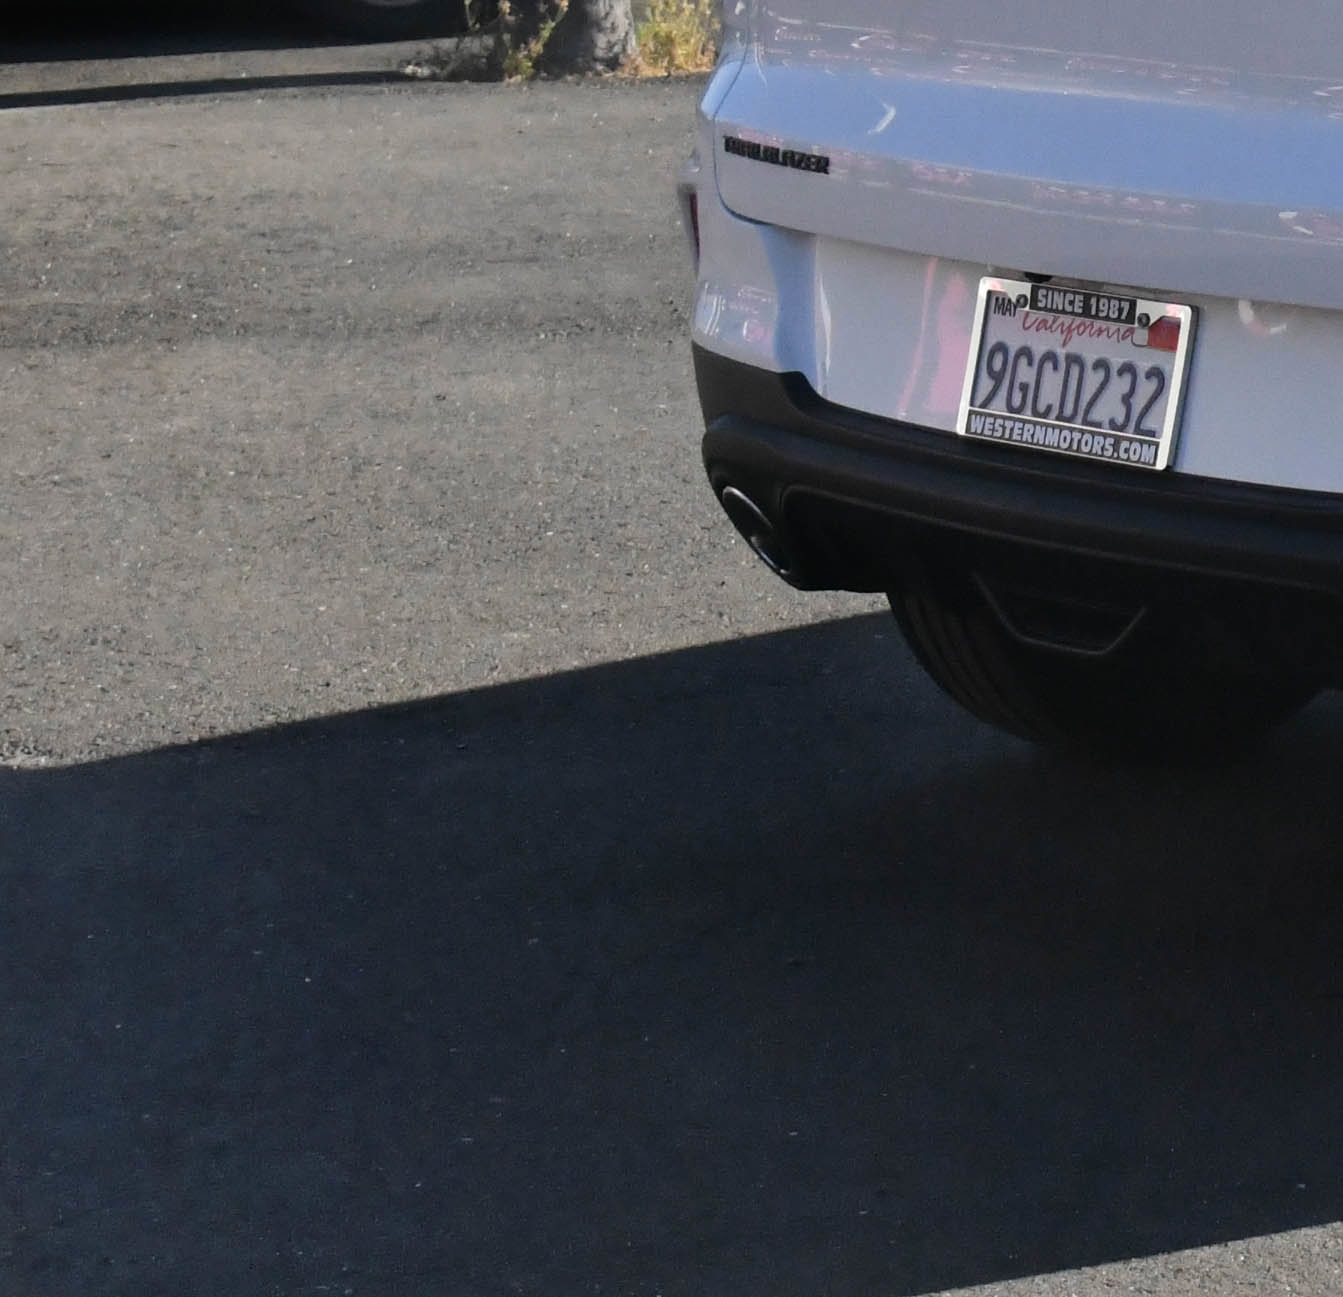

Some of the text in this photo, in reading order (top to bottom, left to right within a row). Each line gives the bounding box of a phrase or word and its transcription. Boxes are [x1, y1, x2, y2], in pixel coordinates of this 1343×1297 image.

[723, 136, 830, 174] TRAILBLAZER
[993, 296, 1018, 318] MAY
[1036, 289, 1130, 320] SINCE 1987
[1022, 311, 1137, 348] California
[976, 341, 1166, 437] 9GCD232
[970, 414, 1157, 465] WESTERNMOTORS.COM
